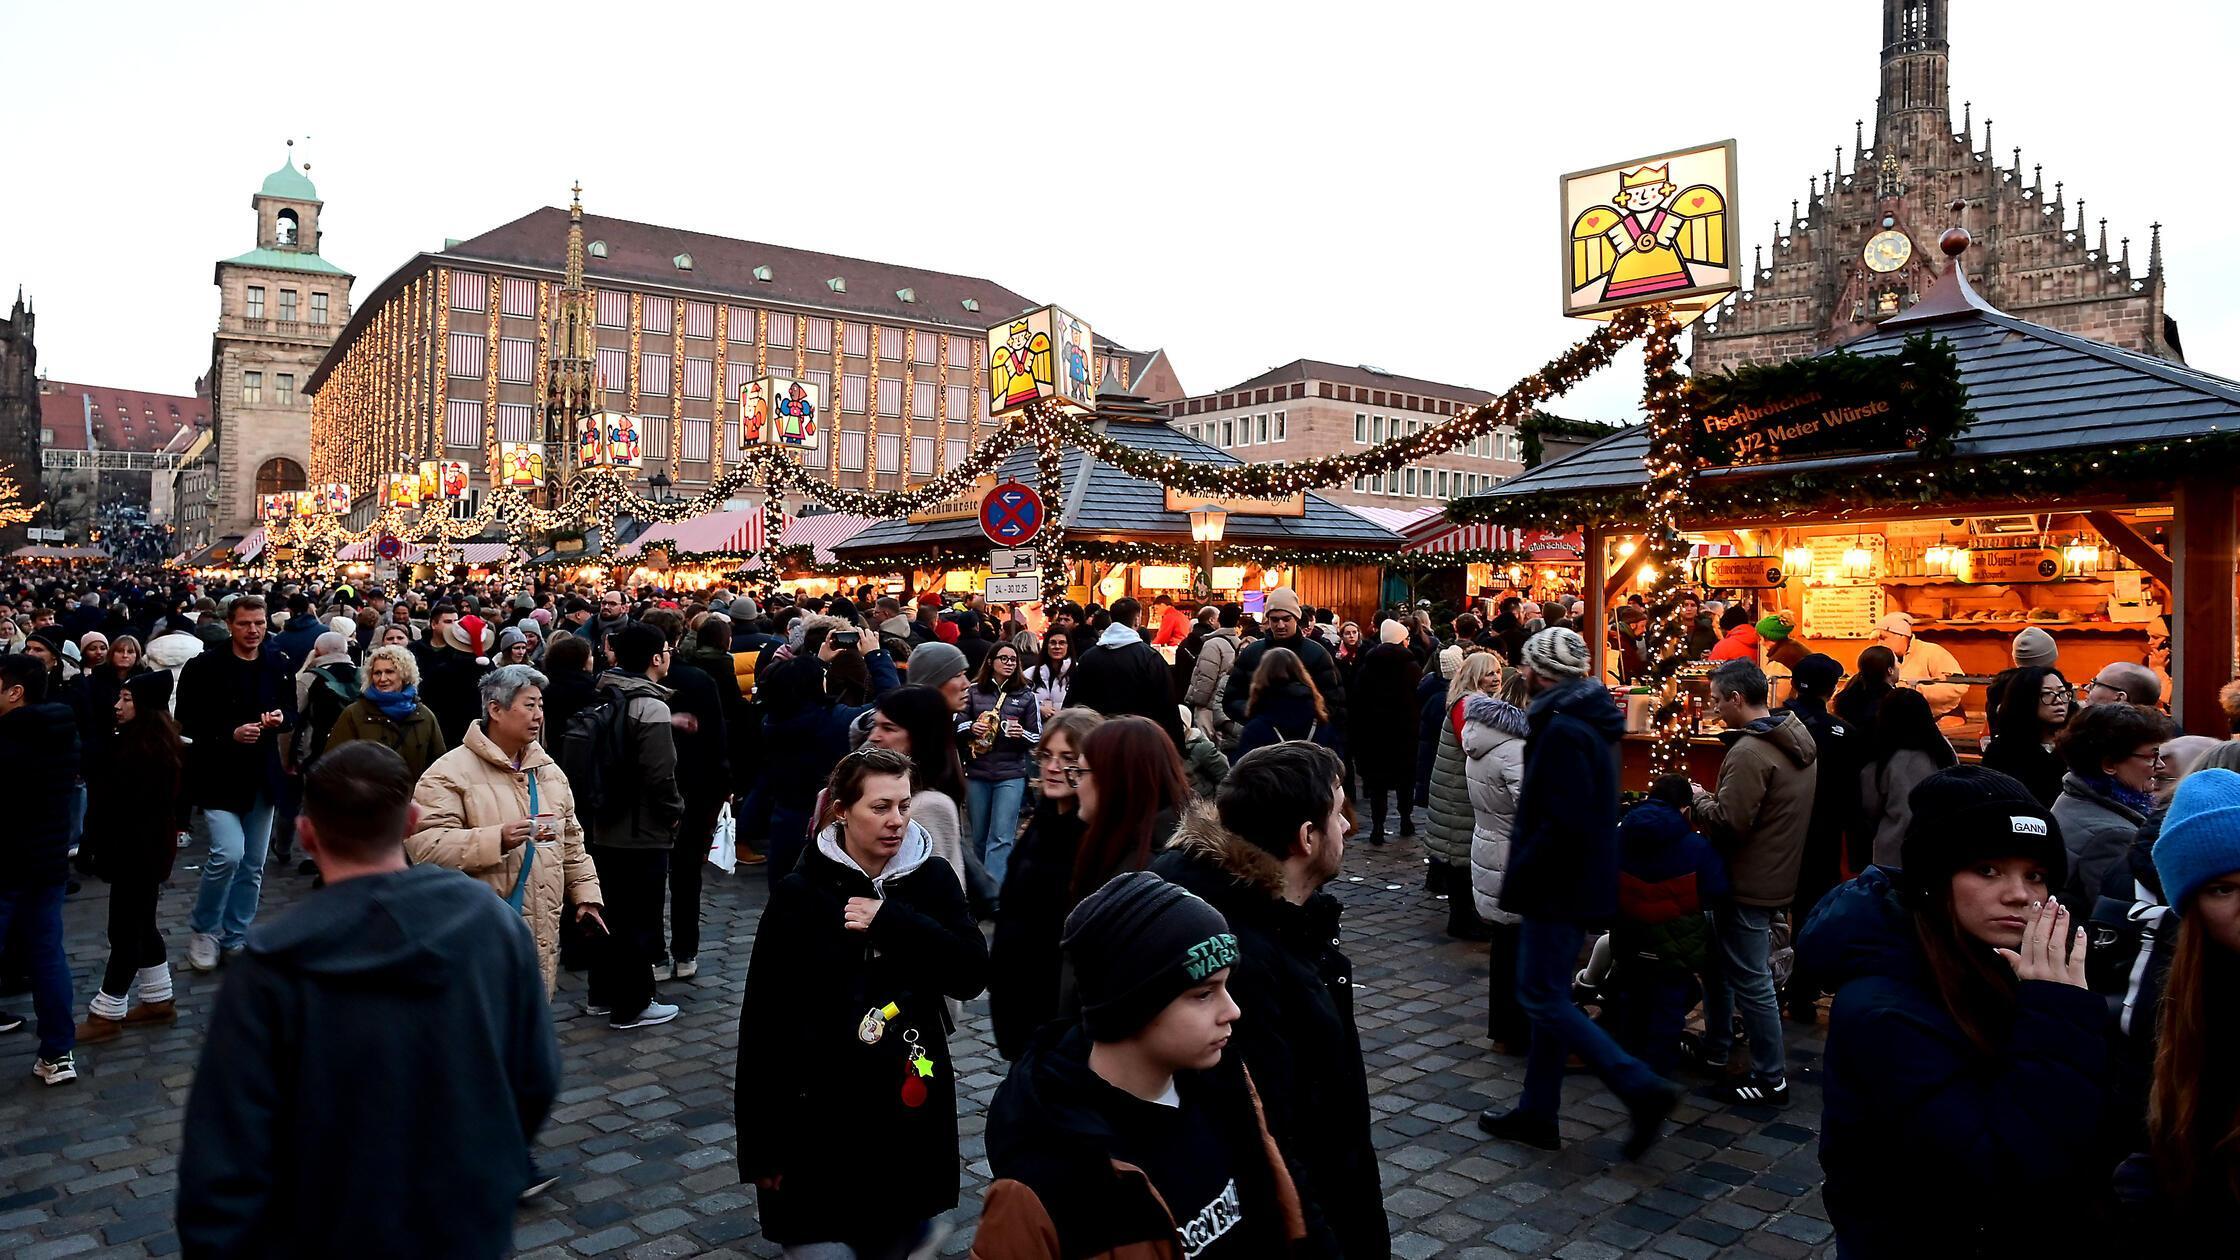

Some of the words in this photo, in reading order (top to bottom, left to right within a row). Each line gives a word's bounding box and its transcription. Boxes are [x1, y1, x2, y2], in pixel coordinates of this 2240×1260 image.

[1767, 418, 1820, 445] Meter
[1821, 400, 1890, 429] Würste
[2014, 822, 2046, 834] GANNI
[1183, 933, 1238, 963] STAR
